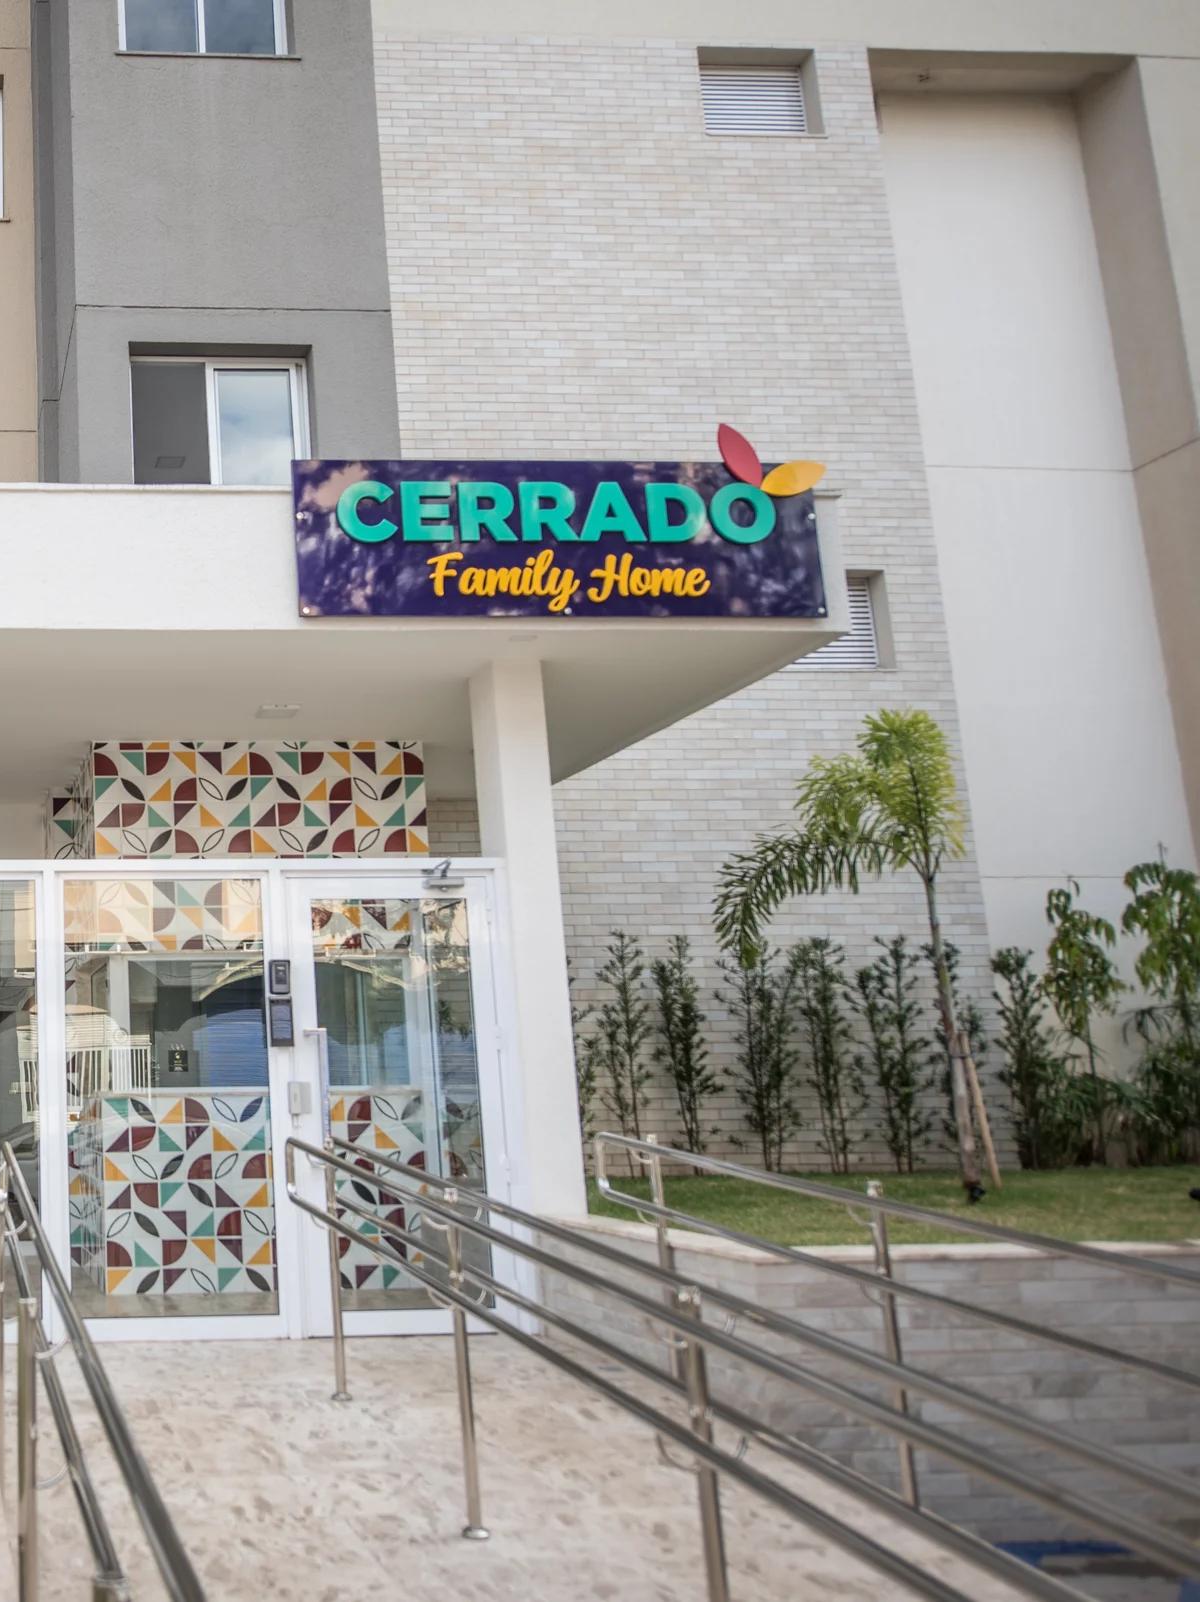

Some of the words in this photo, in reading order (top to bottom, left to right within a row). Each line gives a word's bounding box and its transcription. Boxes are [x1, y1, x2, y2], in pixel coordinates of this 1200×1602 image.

[336, 480, 777, 545] CERRADO
[426, 549, 581, 612] Family
[586, 552, 712, 603] Home
